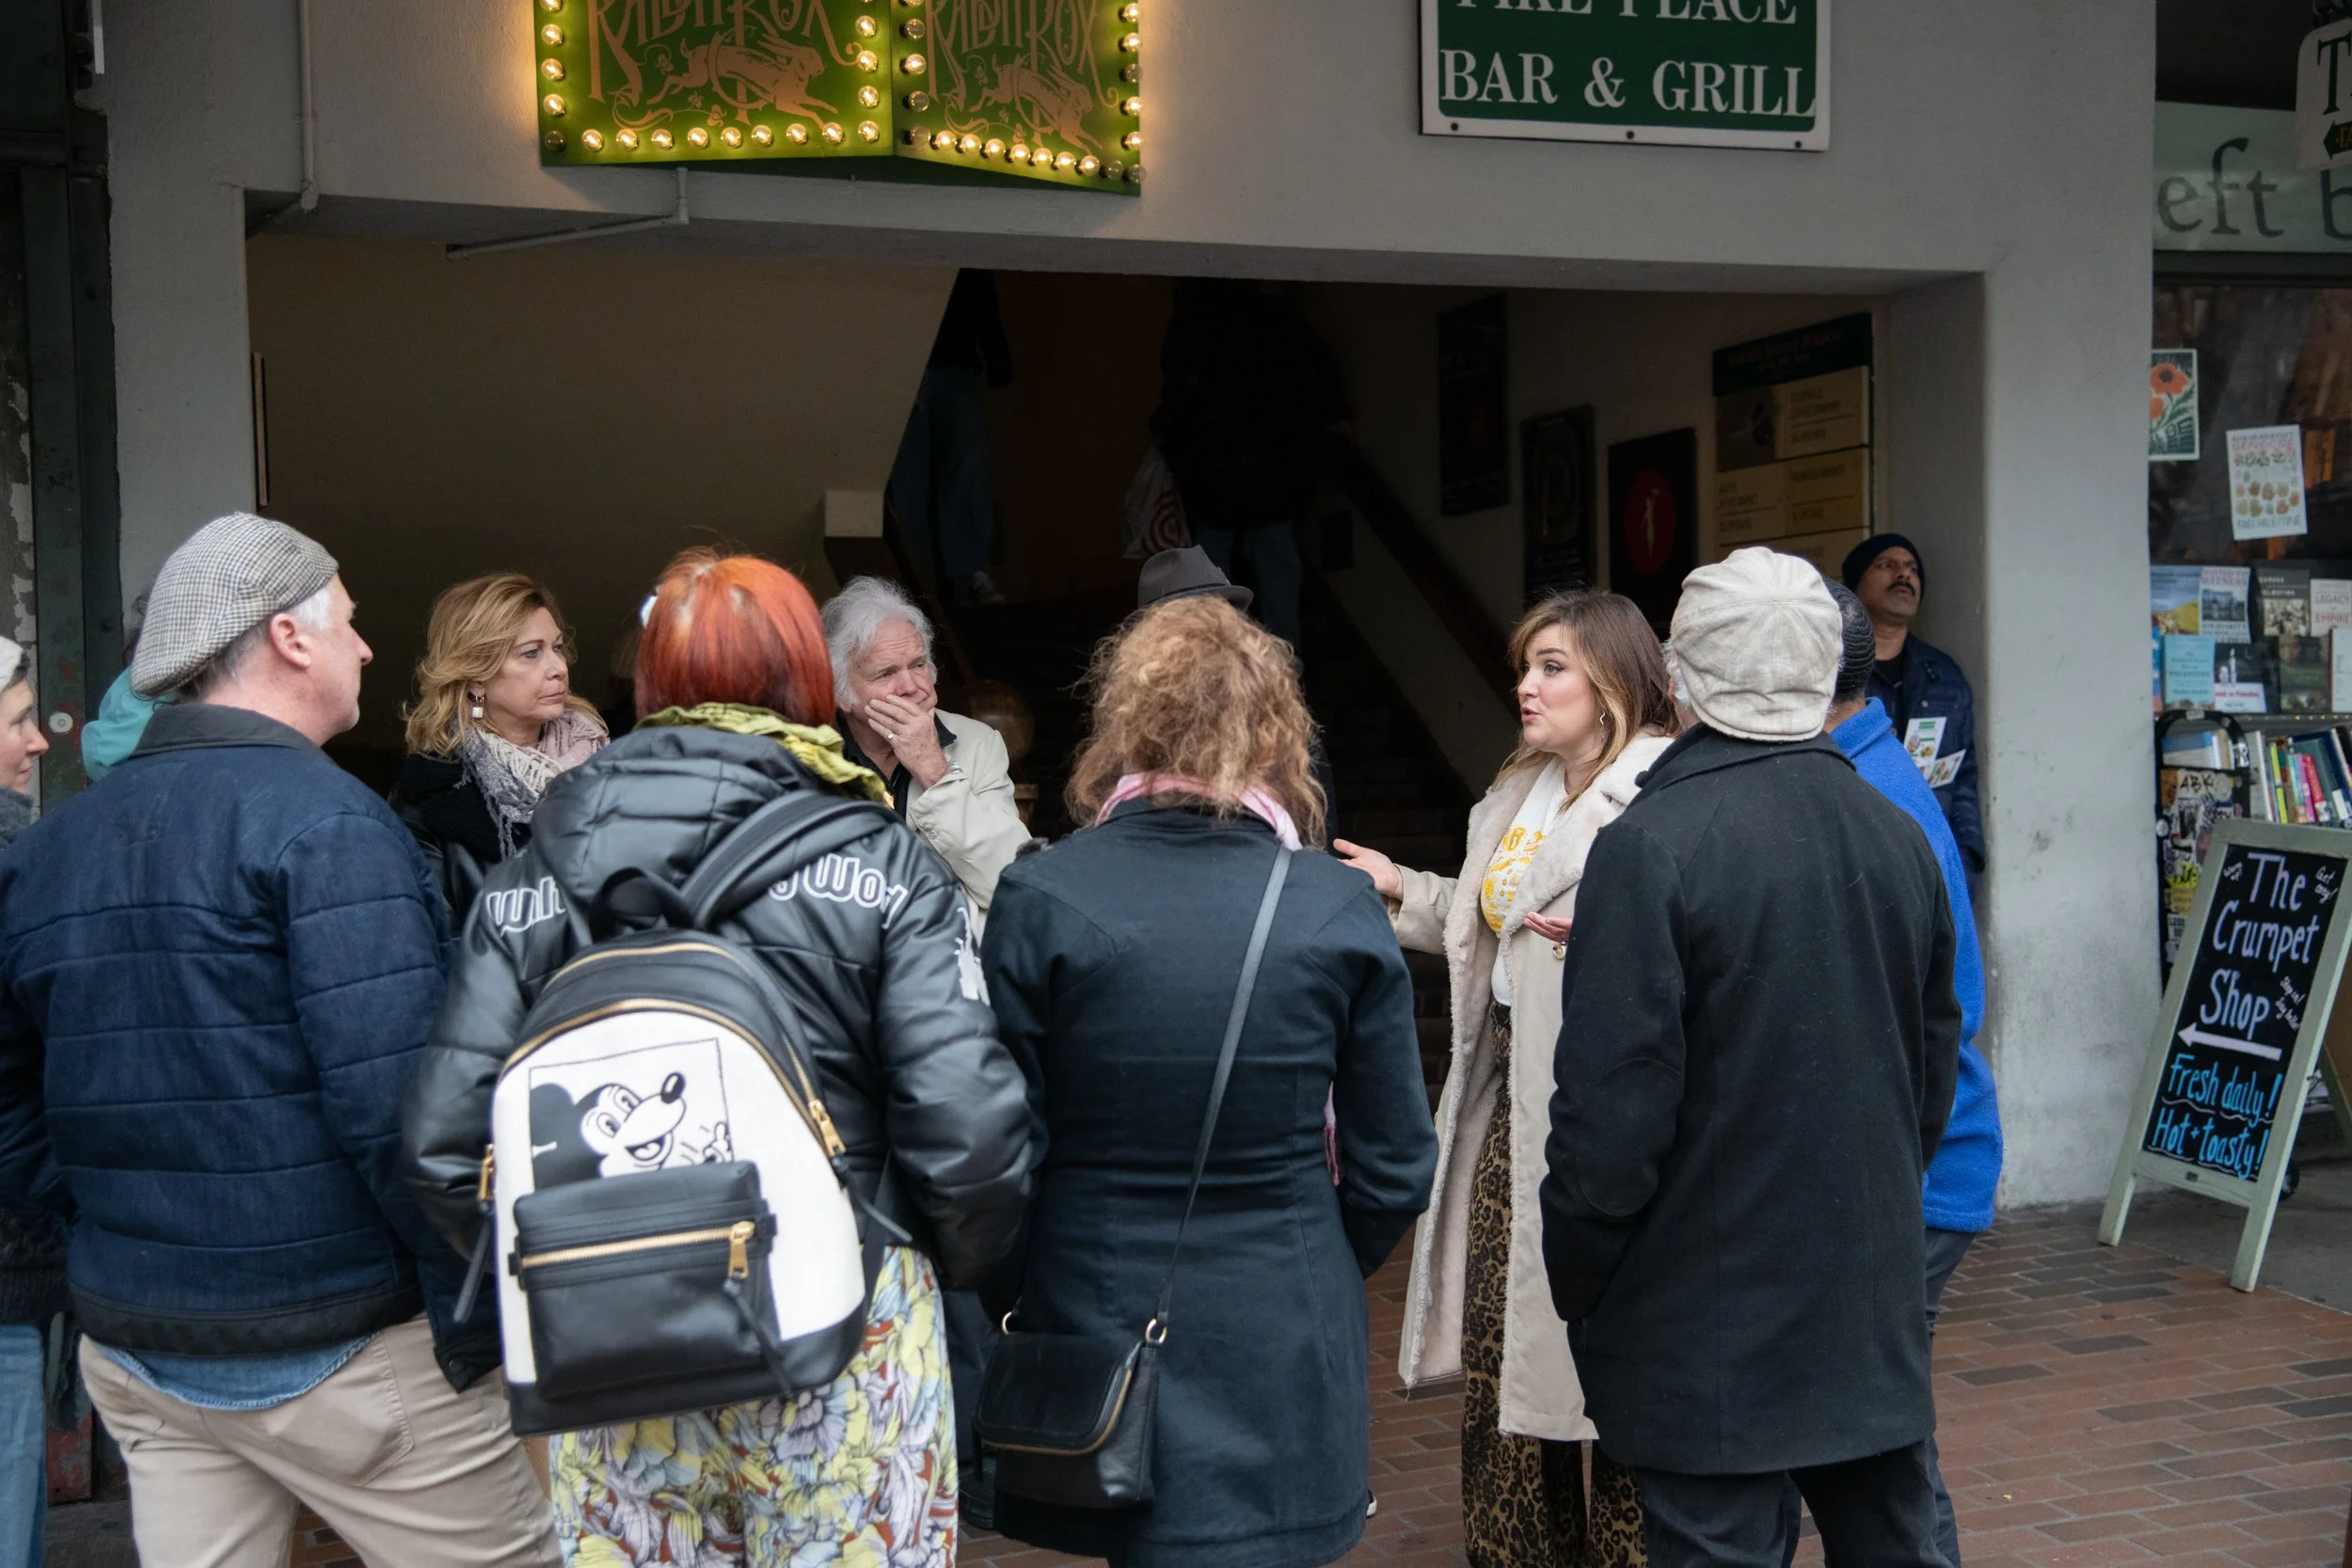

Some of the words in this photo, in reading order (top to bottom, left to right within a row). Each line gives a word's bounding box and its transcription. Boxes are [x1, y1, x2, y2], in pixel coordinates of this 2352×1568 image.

[1439, 49, 1558, 104] BAR
[1583, 56, 1627, 108] &
[1652, 59, 1816, 118] GRILL
[2157, 137, 2284, 238] eft
[2248, 852, 2306, 911] The
[2213, 899, 2320, 973] Crumpet
[2200, 968, 2270, 1040] Shop
[2168, 1053, 2219, 1106] Fresh
[2151, 1107, 2186, 1156] Hot
[2201, 1117, 2269, 1180] toasty!
